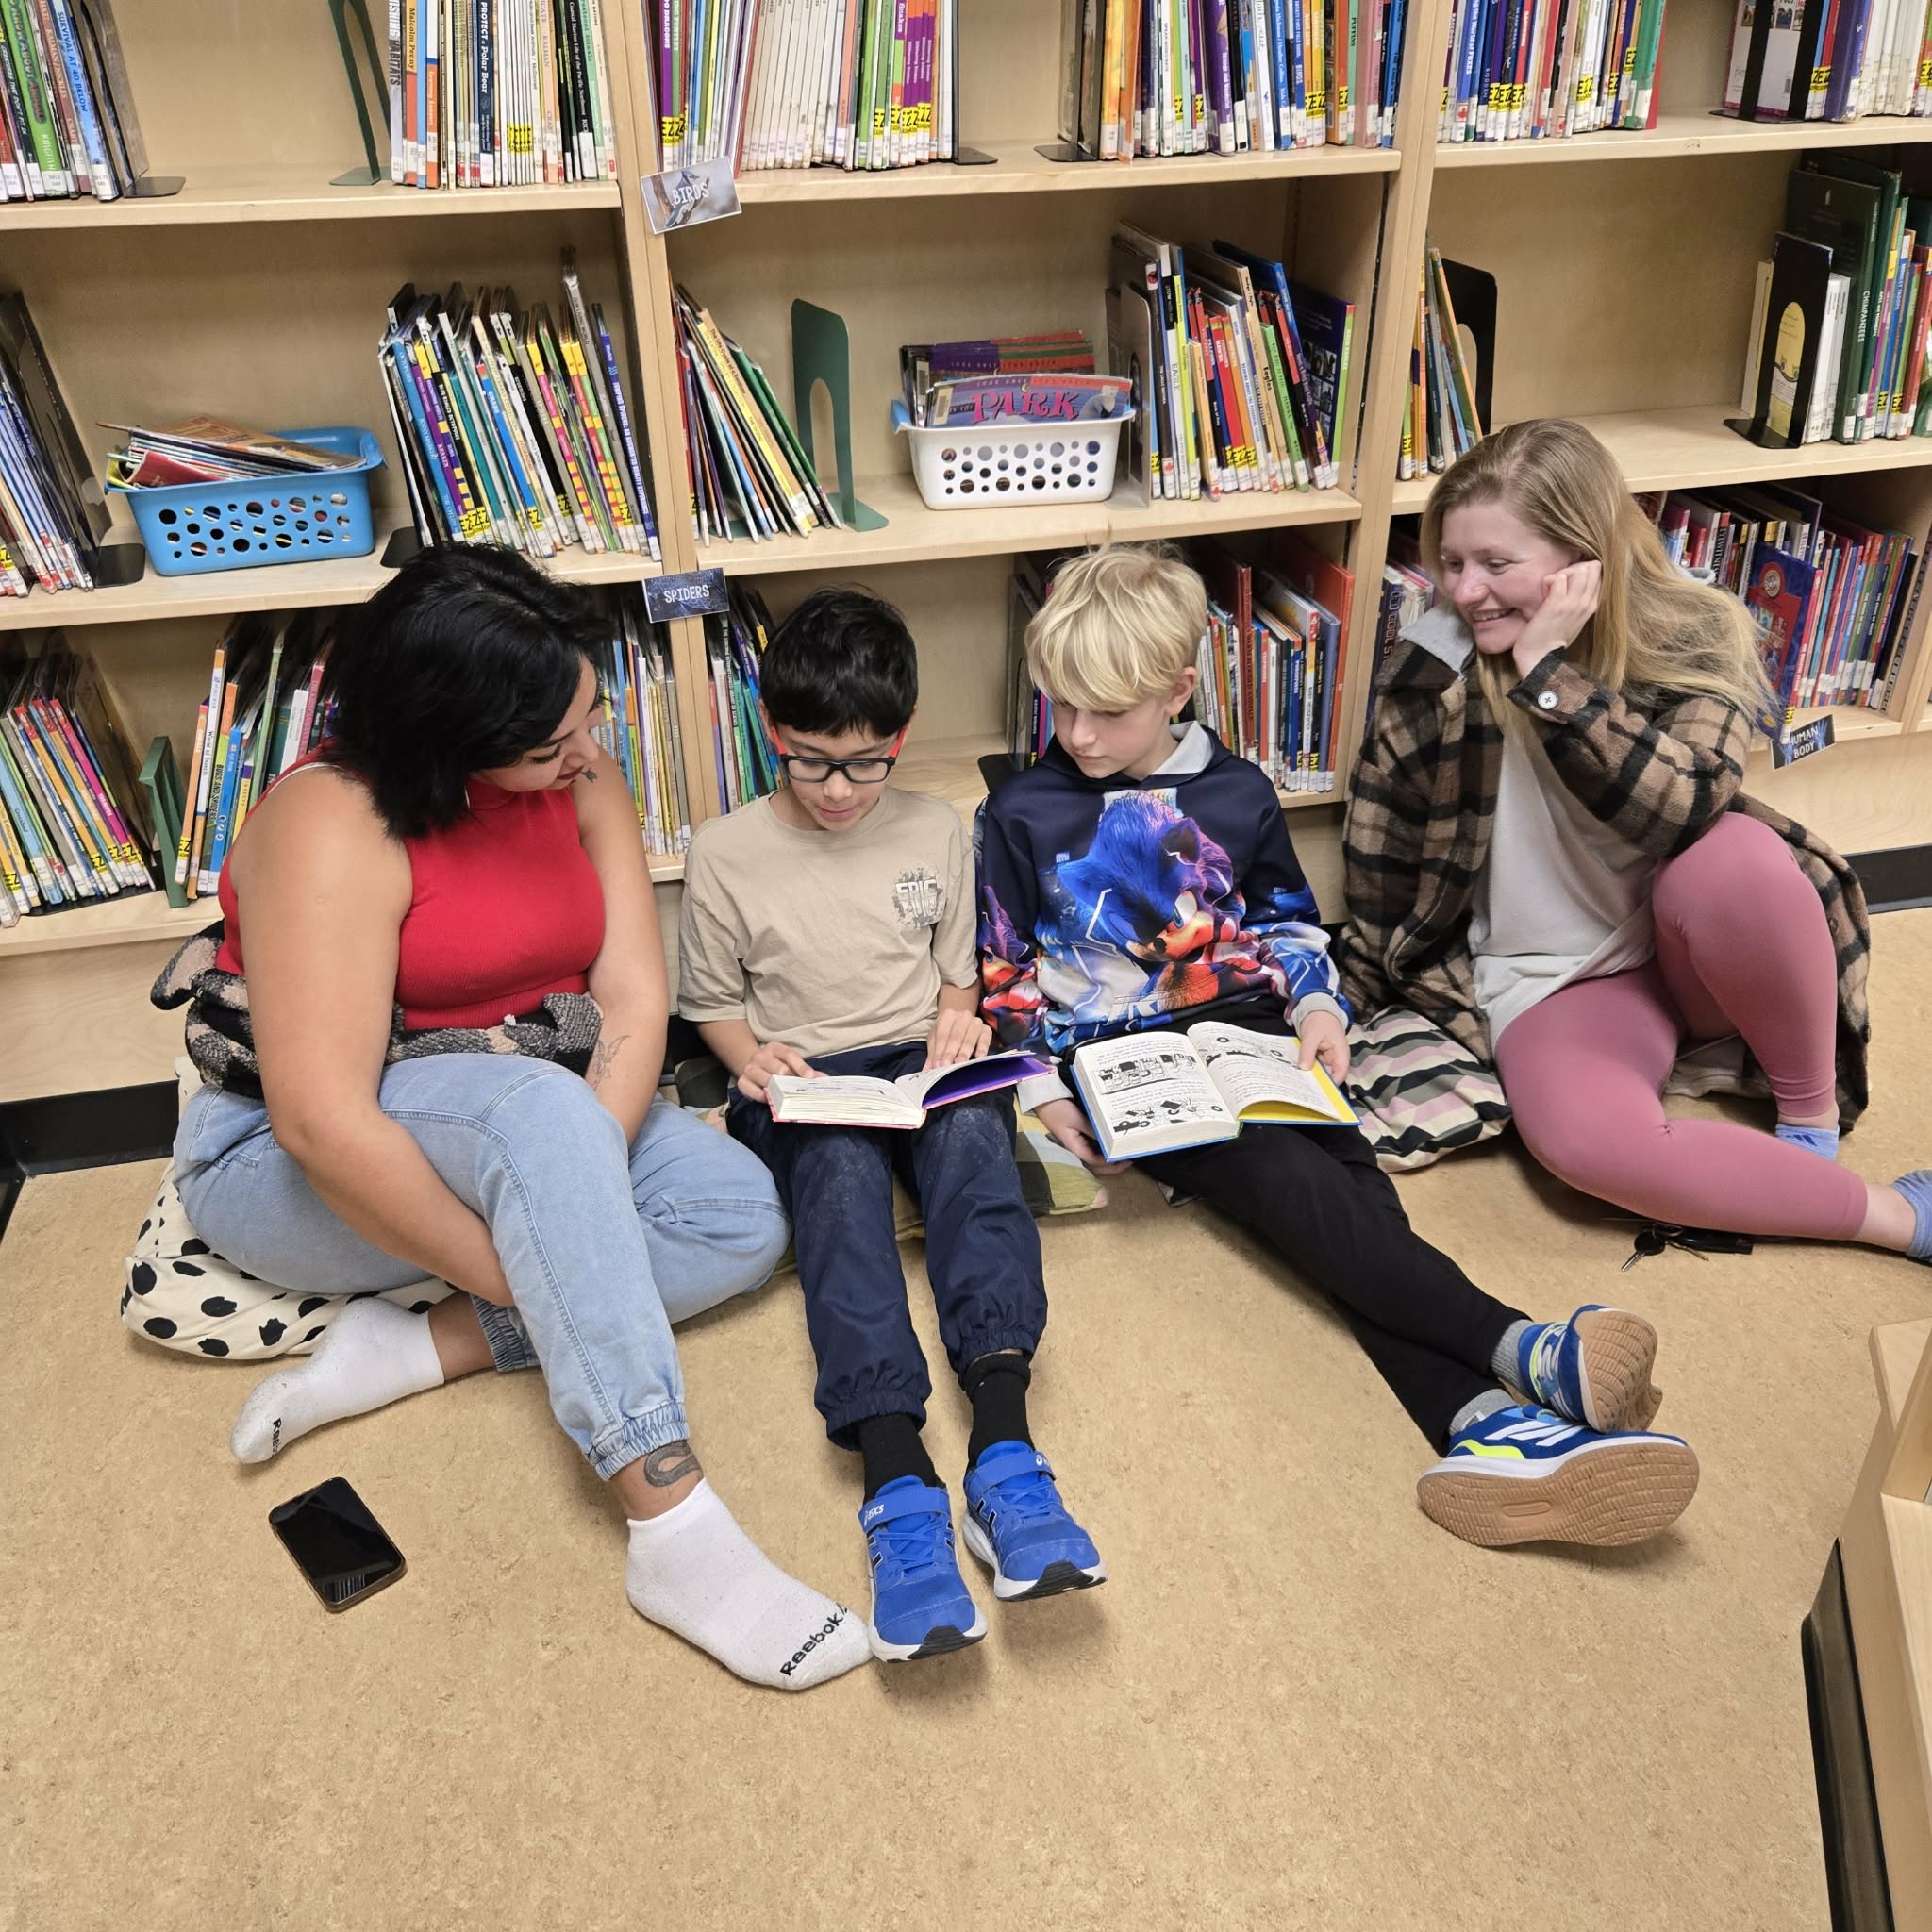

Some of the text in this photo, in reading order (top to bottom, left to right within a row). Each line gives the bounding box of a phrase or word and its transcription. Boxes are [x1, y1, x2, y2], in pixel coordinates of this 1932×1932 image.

[895, 3, 906, 33] Snakes
[1470, 21, 1478, 42] World
[57, 10, 89, 112] SURVIVAL AT 40 BELOW
[390, 39, 401, 85] HABITATS
[1465, 50, 1474, 74] FOXES
[673, 182, 709, 205] BIRDS
[1857, 290, 1870, 343] CHIMPANZEES
[580, 326, 591, 345] WORLD
[710, 328, 719, 339] The
[715, 338, 724, 349] Life
[720, 348, 731, 364] Cycle
[733, 374, 747, 394] Swallow
[1171, 362, 1180, 391] EAGLE
[1261, 365, 1276, 391] Eagles
[488, 391, 500, 413] CRABS
[971, 389, 1080, 424] PARK
[663, 584, 709, 604] SPIDERS
[1385, 612, 1398, 643] COOL
[206, 730, 214, 748] World
[1789, 724, 1819, 745] HUMAN
[1793, 742, 1816, 758] BODY
[23, 763, 32, 779] ANTS
[202, 757, 210, 776] Insects
[209, 763, 225, 821] BUGS AND SPIDERS
[895, 879, 937, 912] EPIC
[779, 1613, 844, 1676] Reebok
